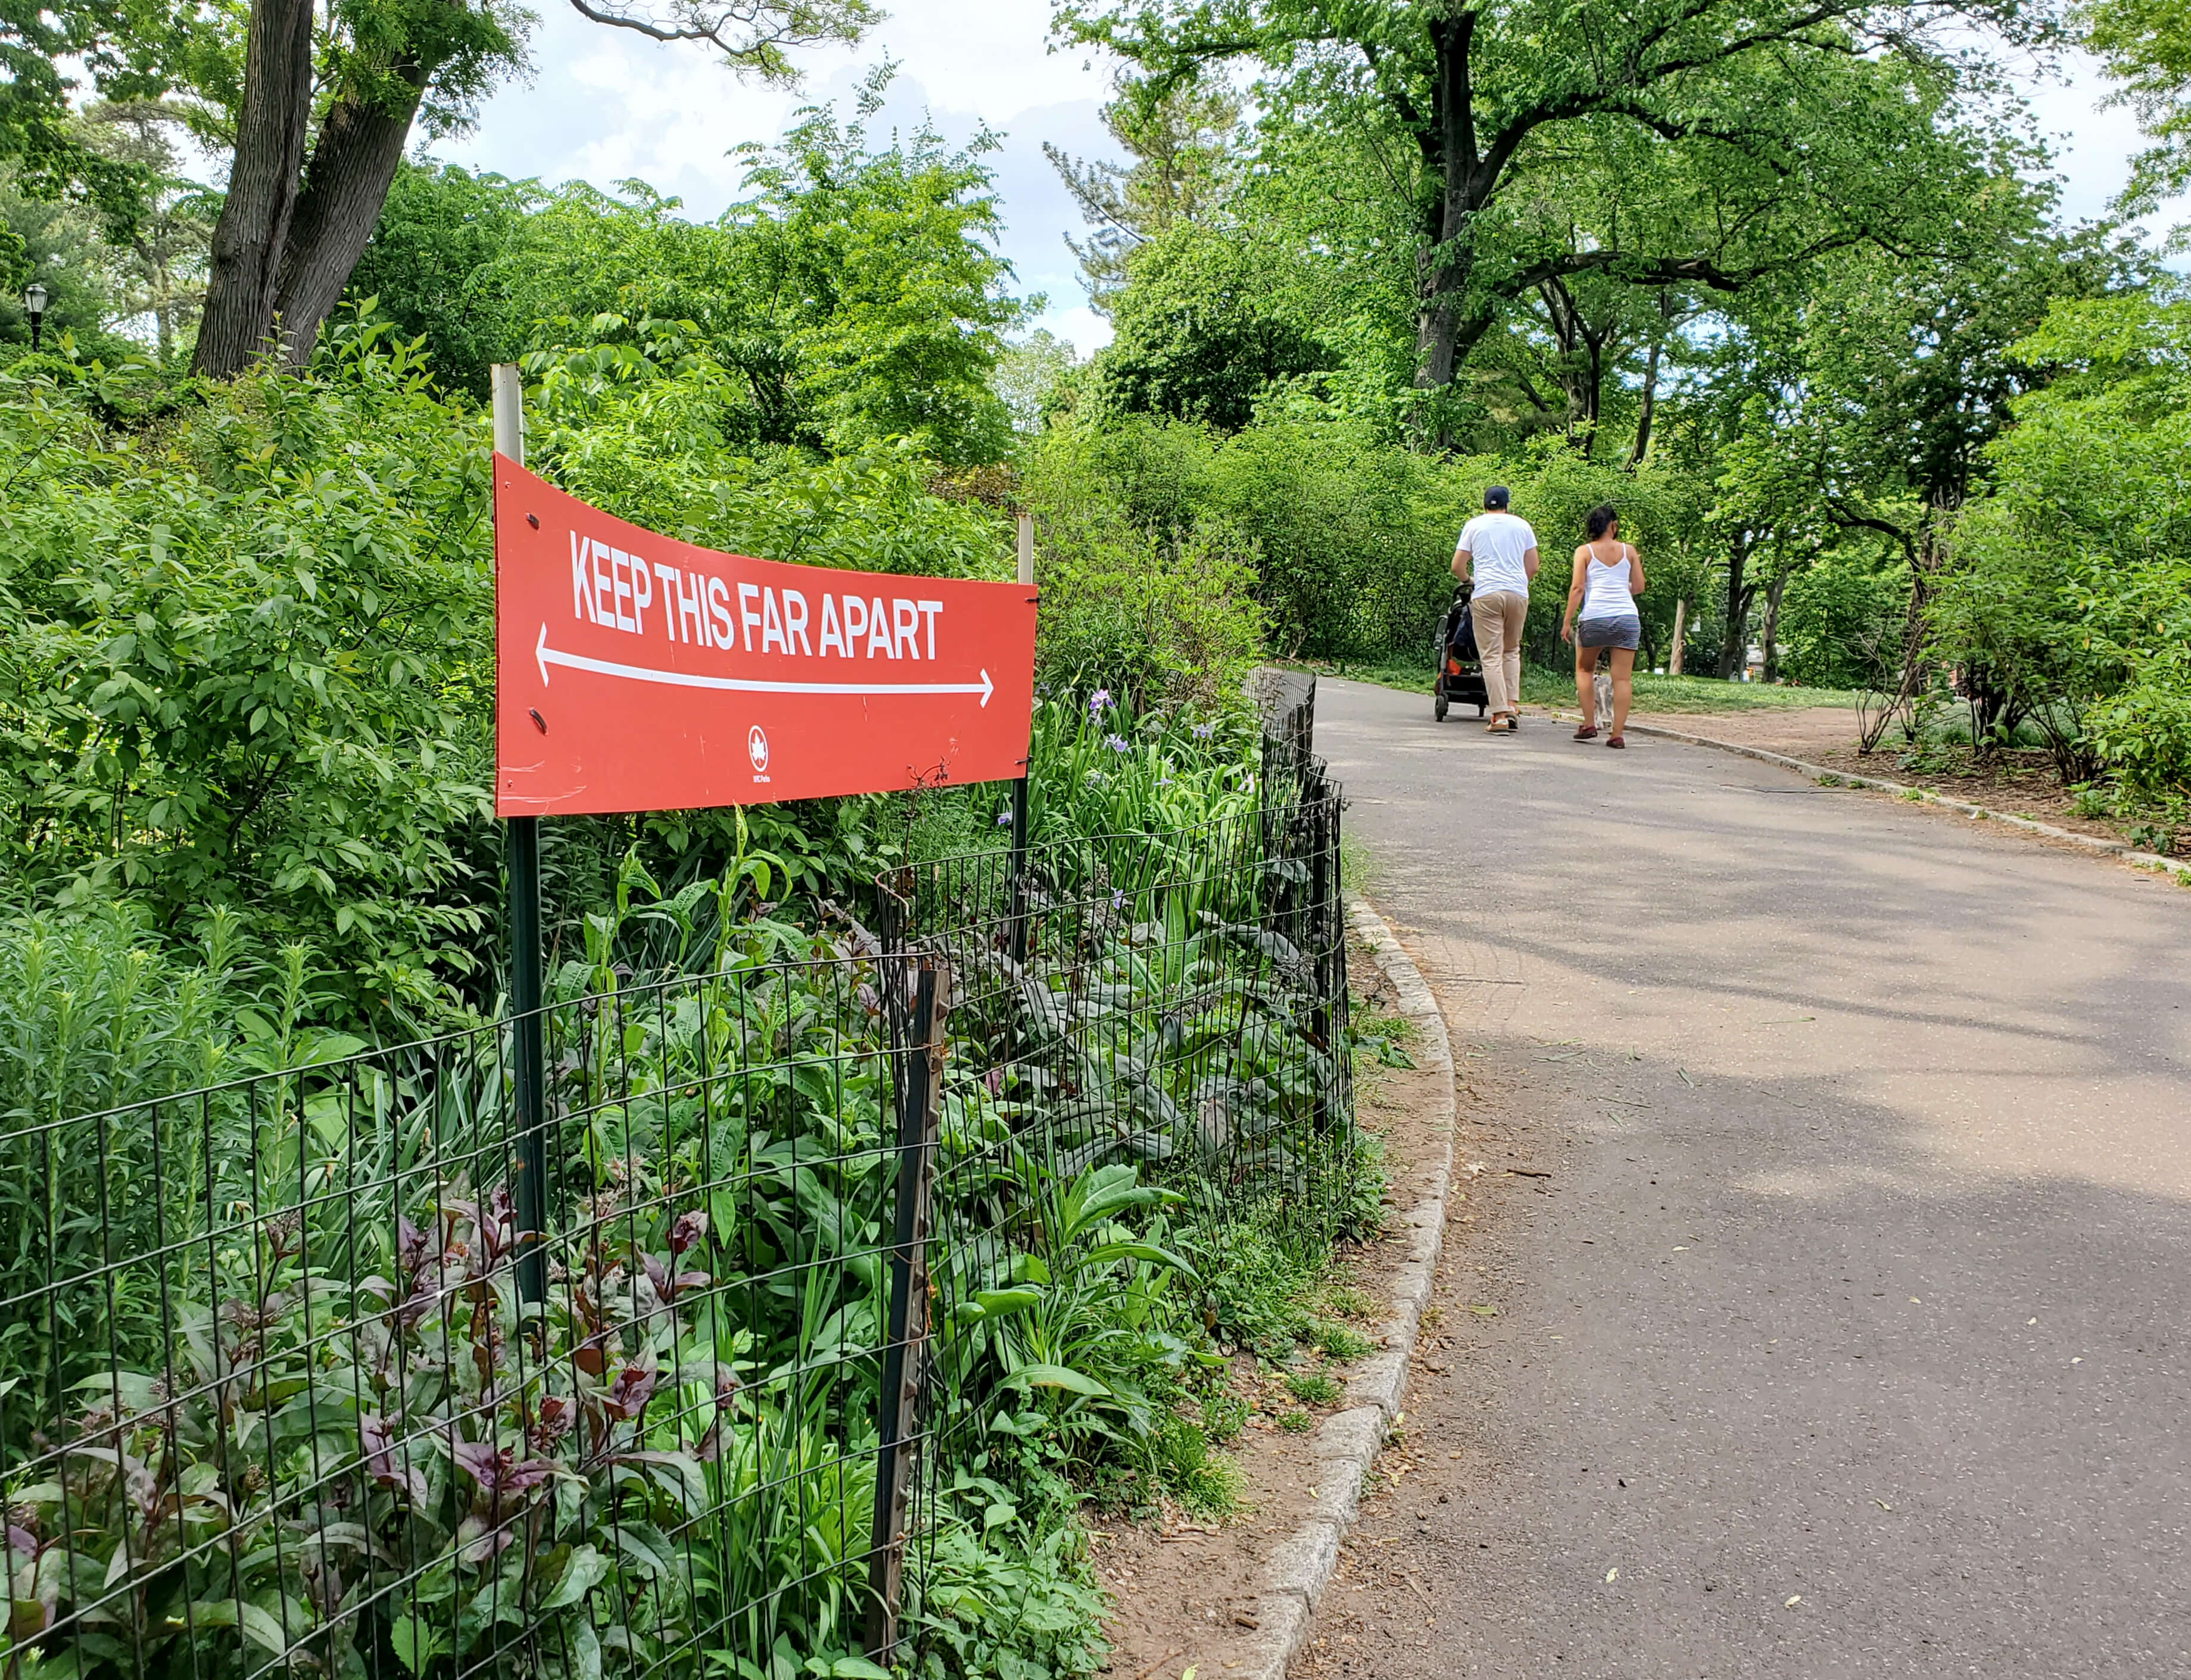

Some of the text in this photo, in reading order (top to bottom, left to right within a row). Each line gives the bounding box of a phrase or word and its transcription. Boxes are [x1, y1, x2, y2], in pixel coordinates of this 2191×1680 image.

[569, 529, 943, 660] KEEP THIS FAR APART
